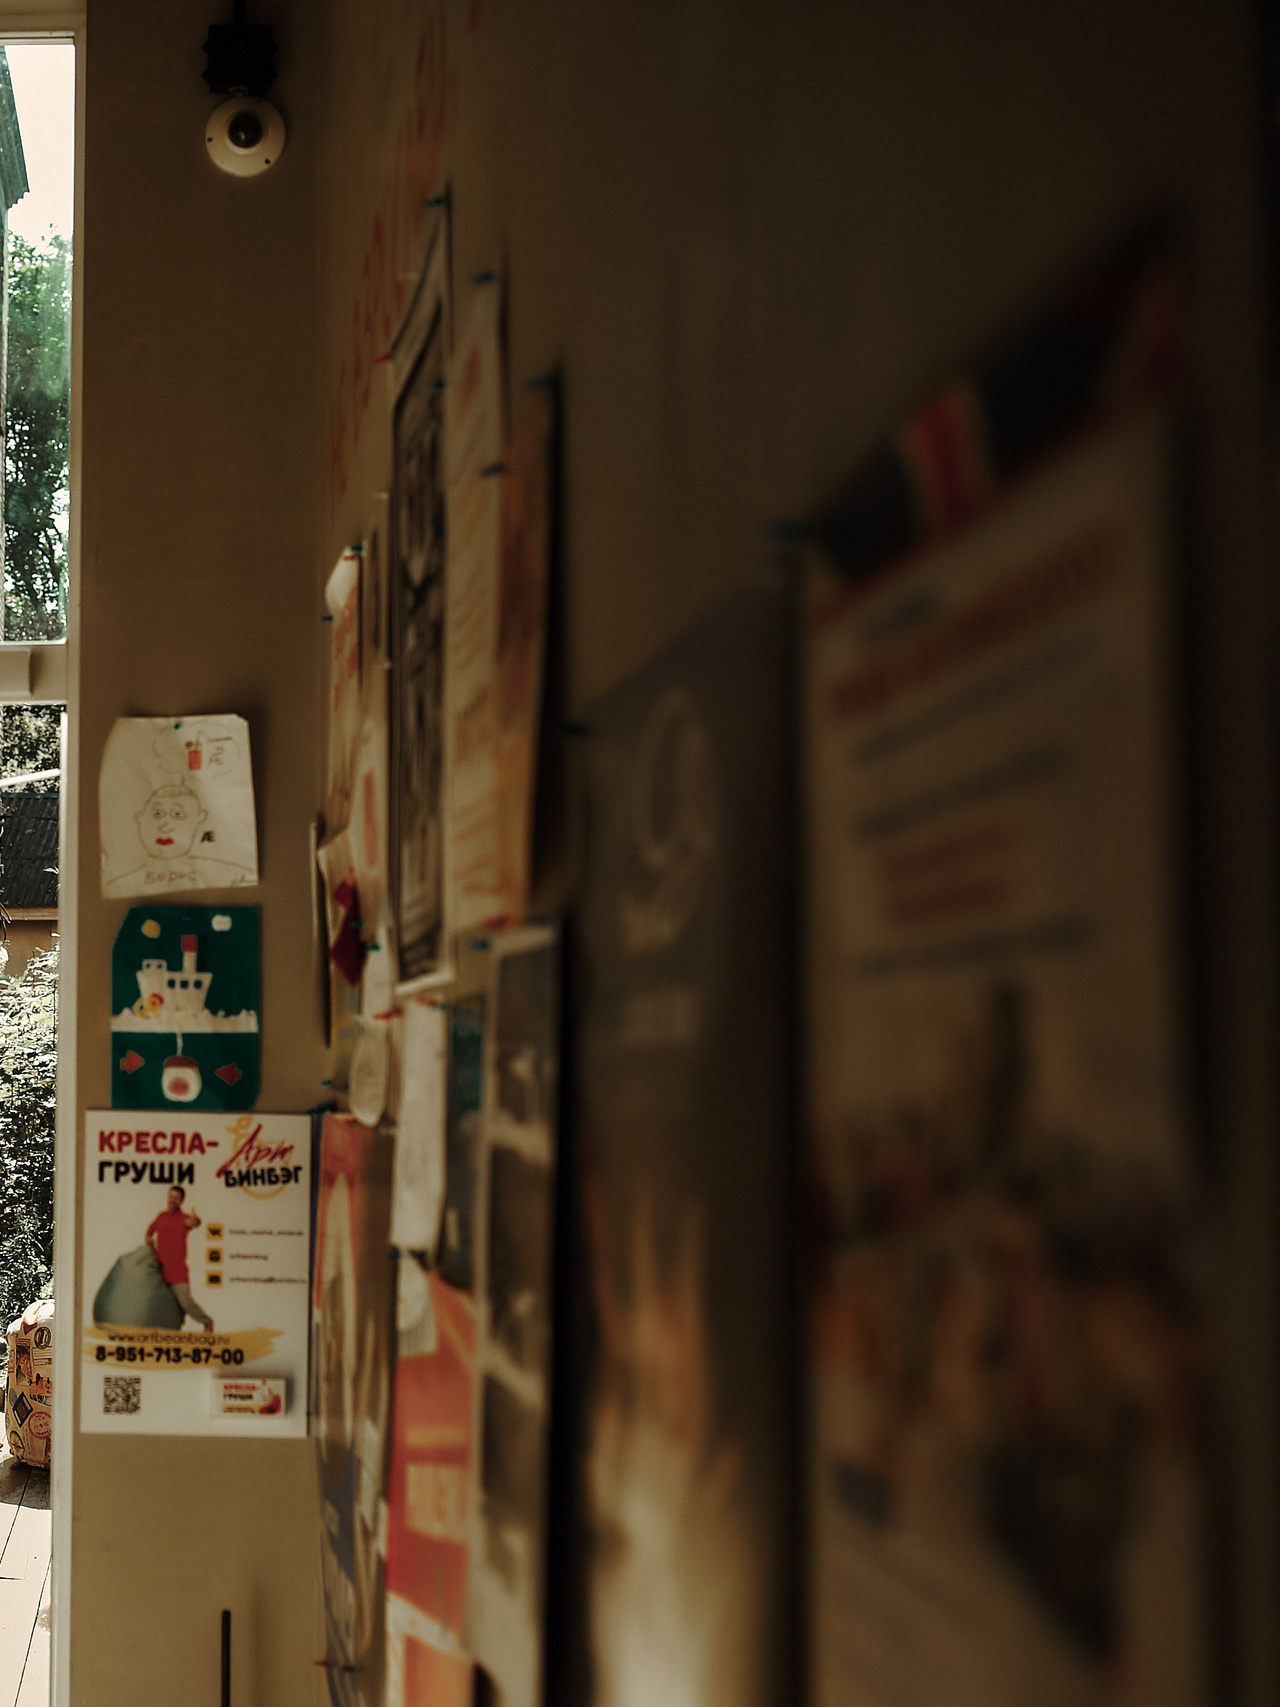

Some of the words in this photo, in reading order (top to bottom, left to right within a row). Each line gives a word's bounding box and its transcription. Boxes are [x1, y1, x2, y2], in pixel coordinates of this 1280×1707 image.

[98, 1131, 219, 1155] КРЕСЛА-
[98, 1161, 195, 1185] ГРУШИ
[224, 1166, 303, 1187] БИНБЭГ
[108, 1333, 231, 1346] www.artbeanbag.ru
[95, 1345, 245, 1365] 8-951-713-87-00
